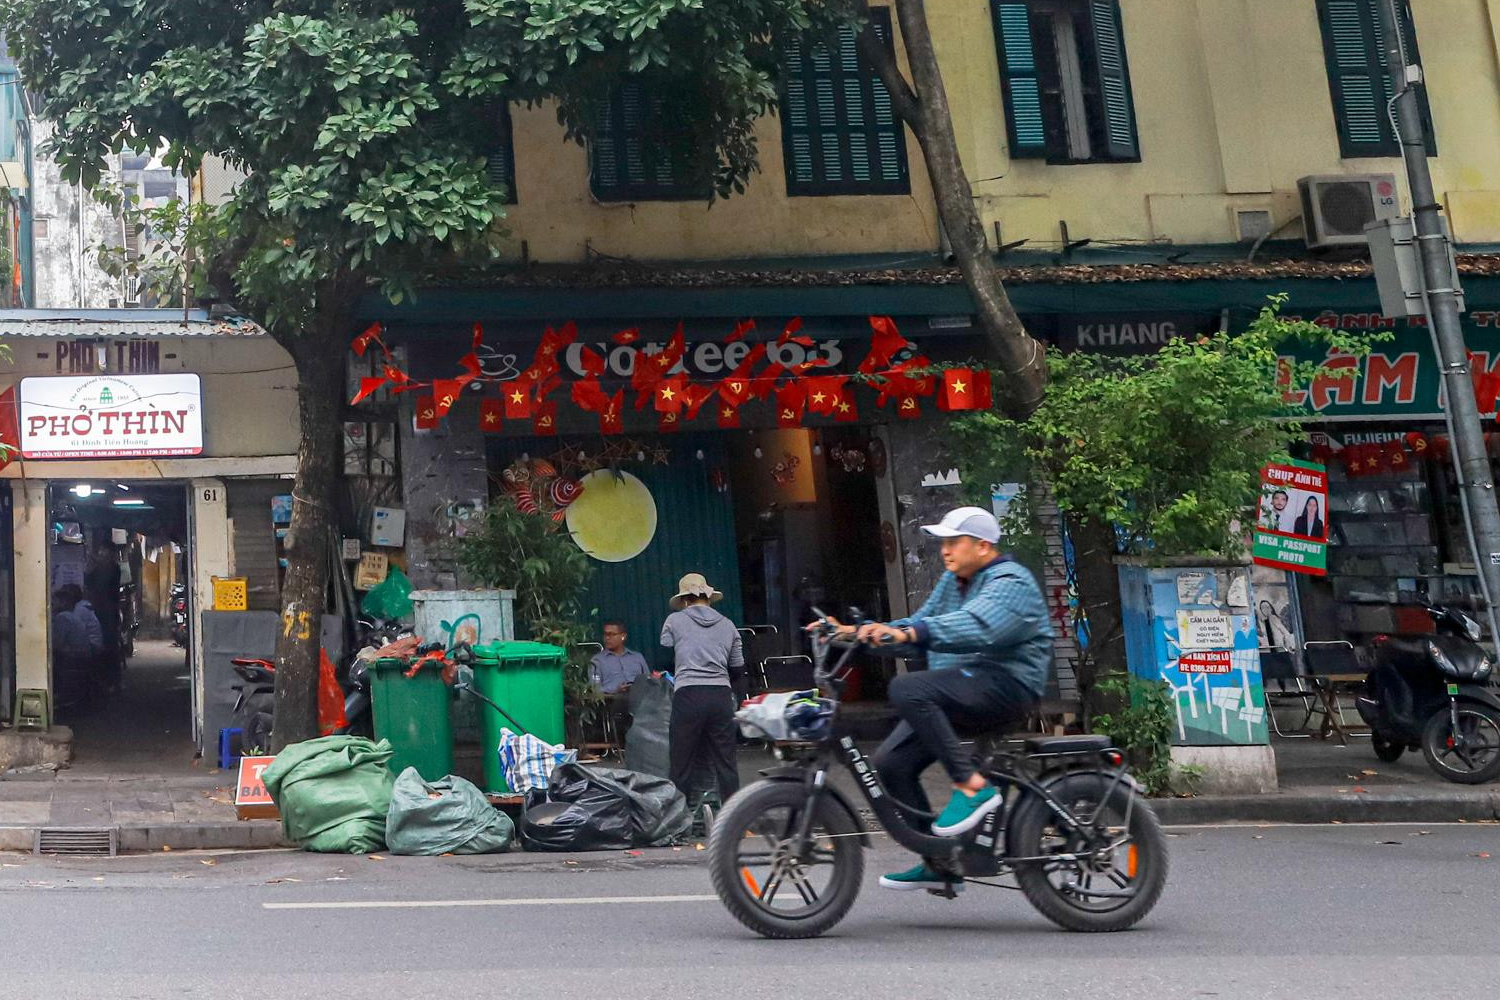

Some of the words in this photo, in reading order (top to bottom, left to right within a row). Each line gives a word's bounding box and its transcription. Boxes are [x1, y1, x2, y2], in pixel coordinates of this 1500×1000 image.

[1381, 197, 1393, 205] LG
[1077, 322, 1176, 347] KHANG
[28, 404, 93, 437] PHỞ
[97, 403, 188, 436] THÌN
[204, 490, 217, 502] 61
[1258, 534, 1278, 547] VISA
[1283, 540, 1322, 554] PASSPORT
[1278, 550, 1304, 563] PHOTO
